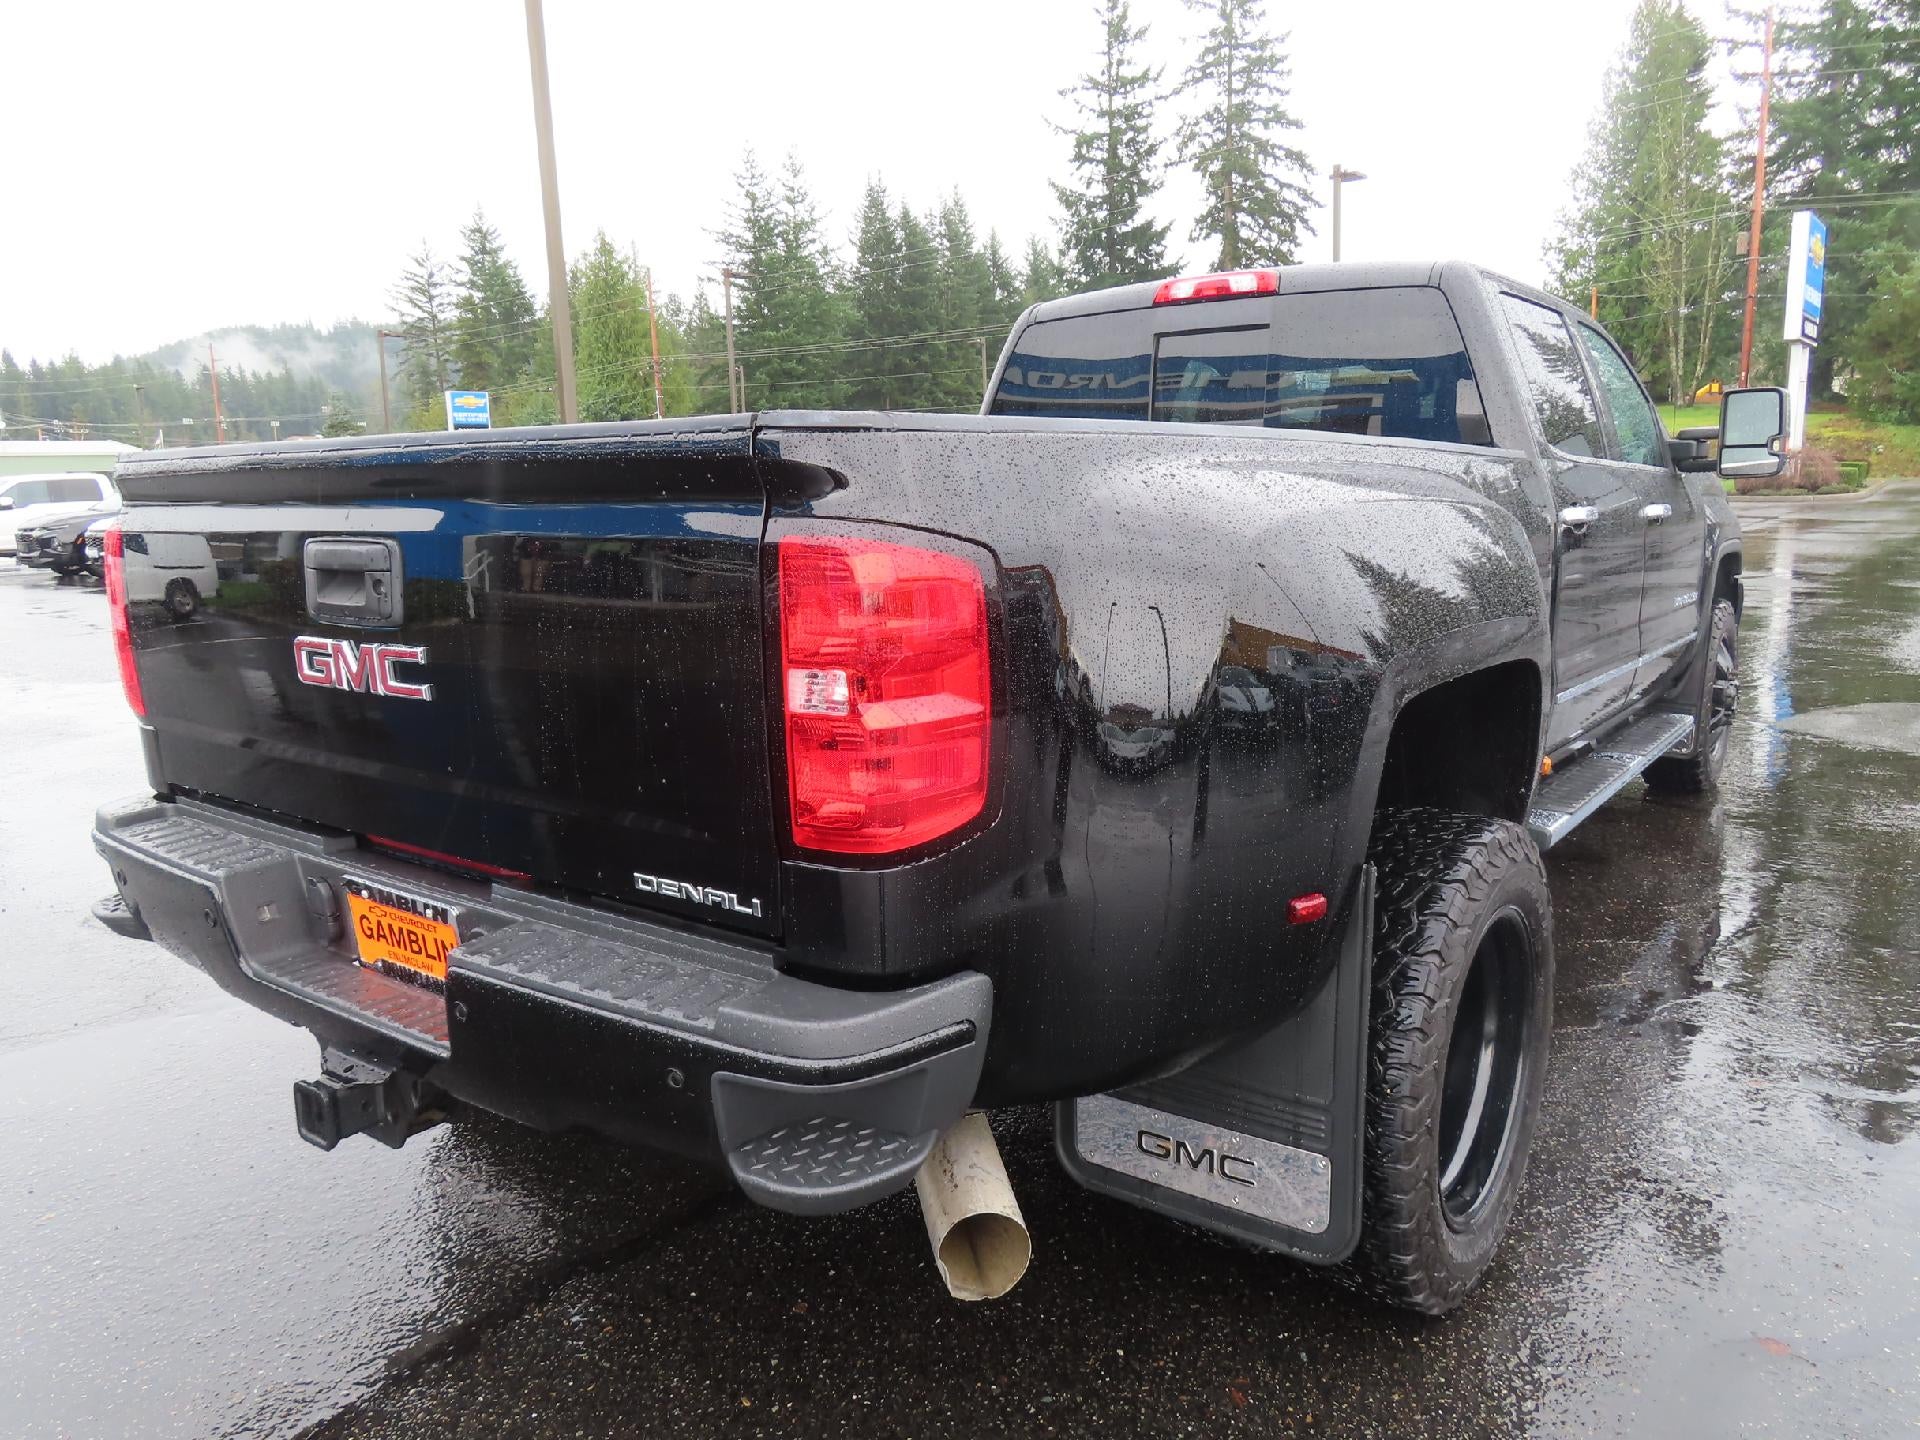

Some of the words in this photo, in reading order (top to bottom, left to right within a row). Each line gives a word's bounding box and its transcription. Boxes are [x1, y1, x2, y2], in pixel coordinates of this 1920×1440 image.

[294, 636, 433, 701] GMC
[633, 872, 762, 918] DENALI
[389, 912, 438, 934] CHEVROLET
[1137, 1129, 1257, 1187] GMC
